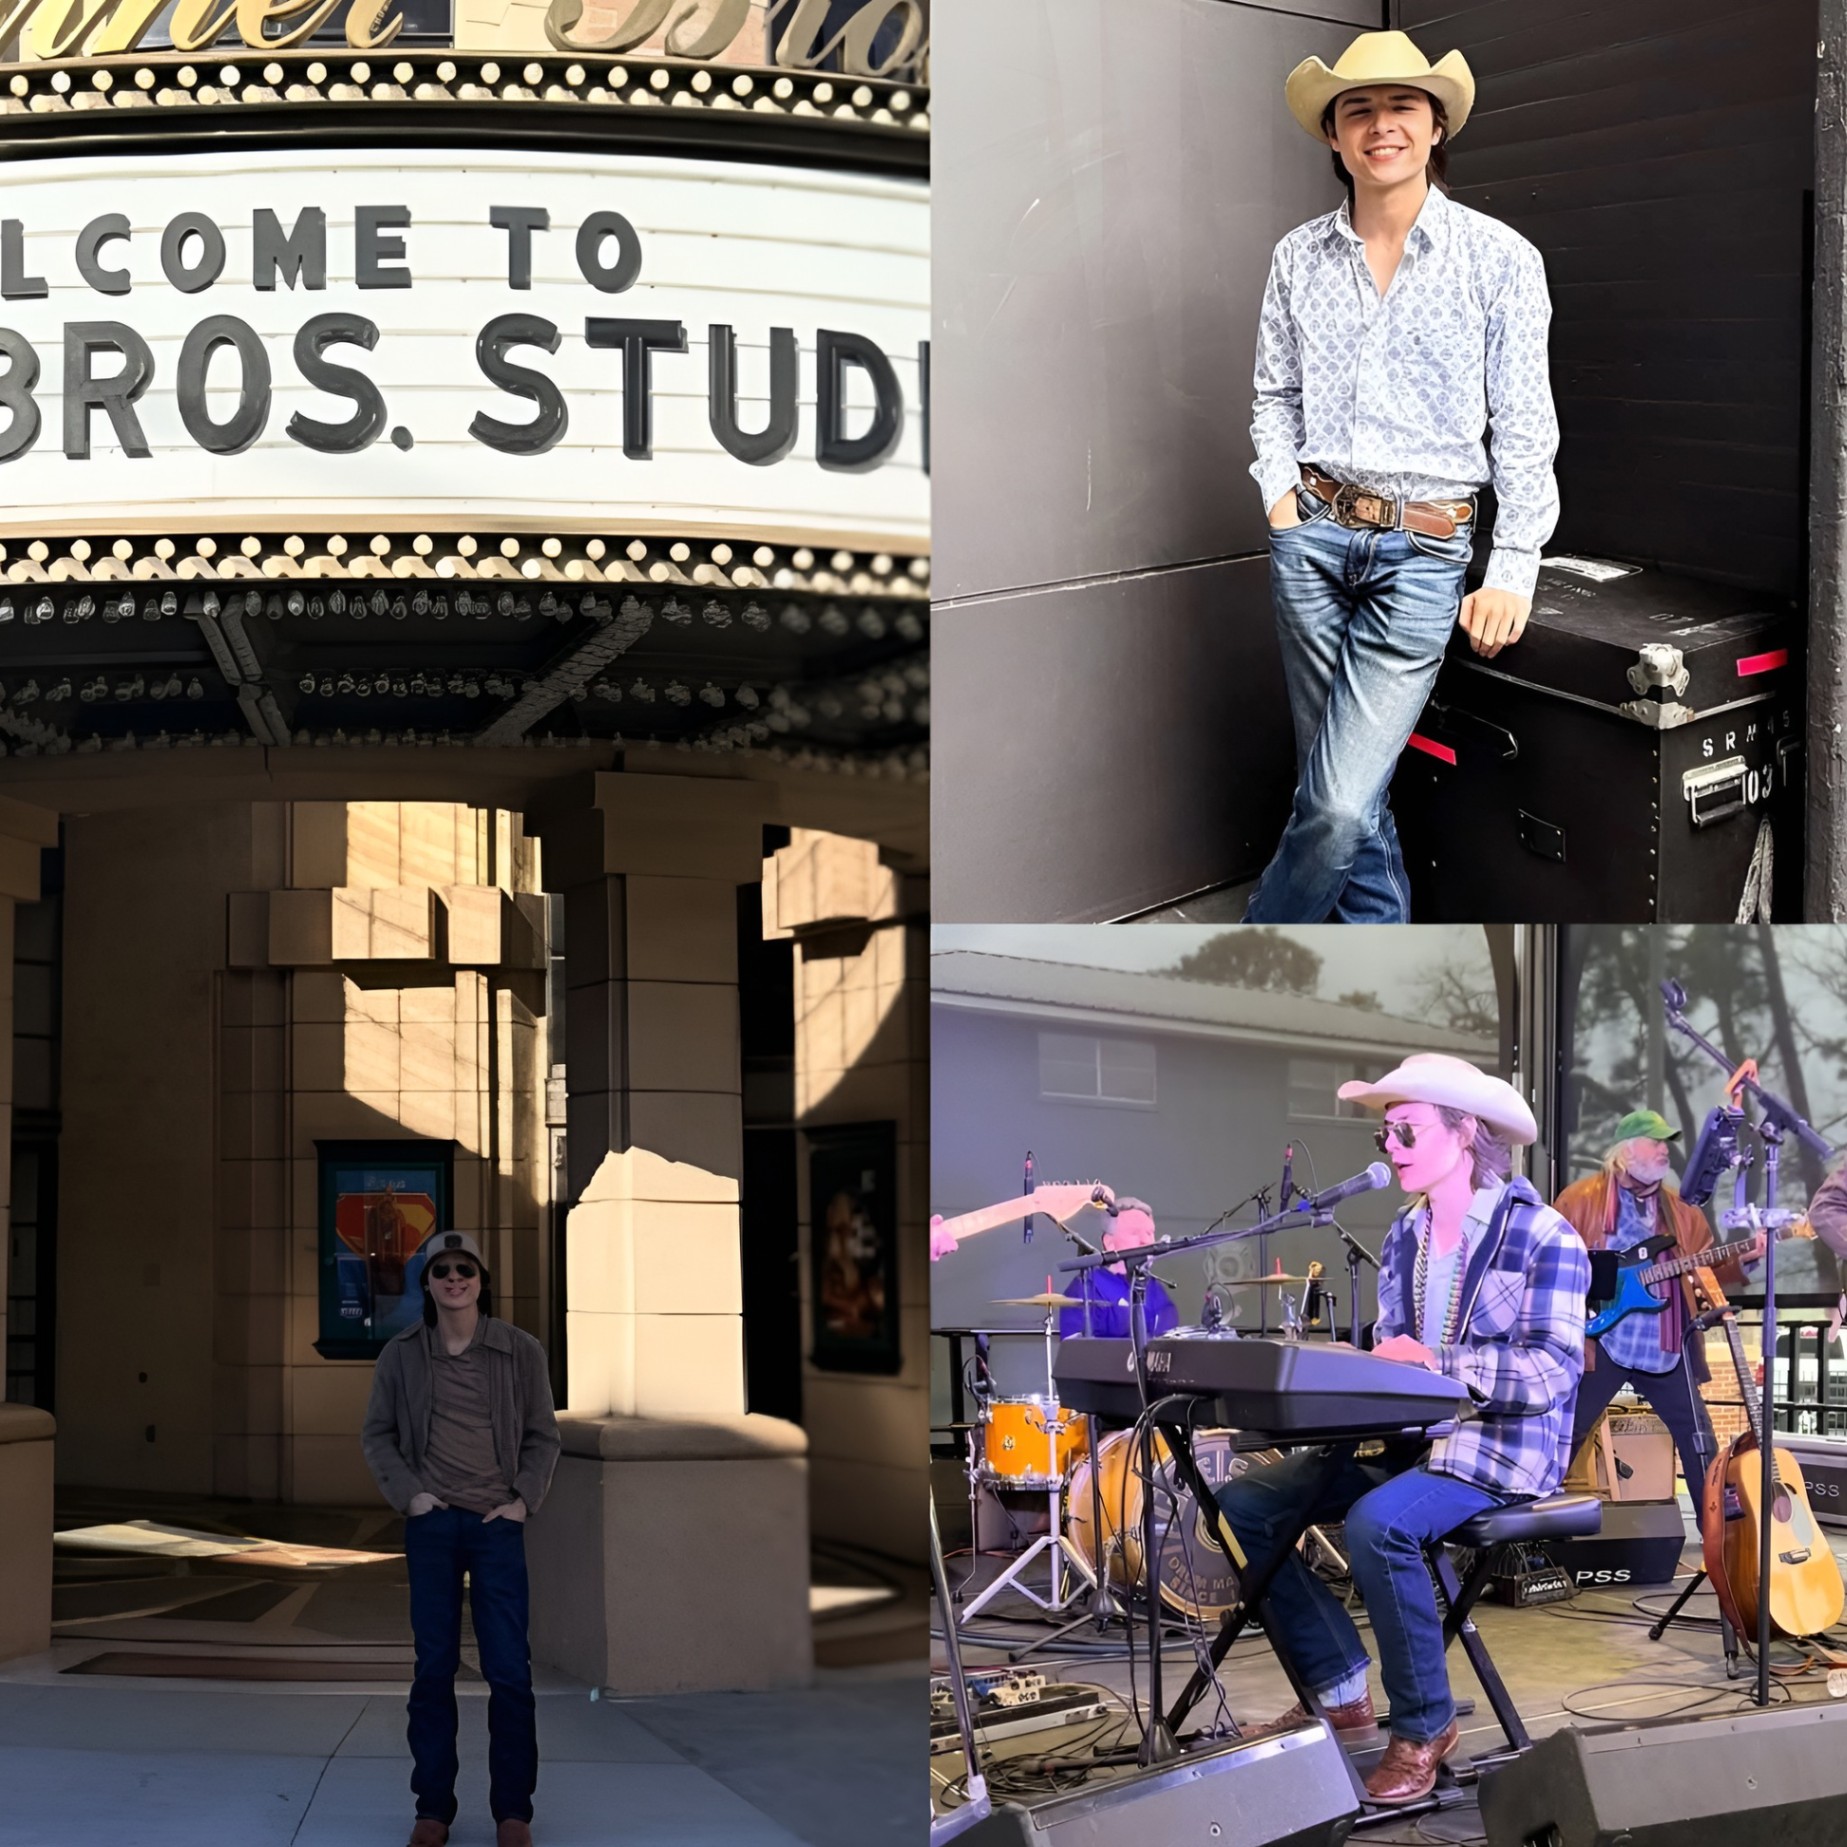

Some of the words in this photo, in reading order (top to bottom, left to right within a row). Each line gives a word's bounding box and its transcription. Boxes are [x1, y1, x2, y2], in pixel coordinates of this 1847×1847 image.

[490, 205, 642, 294] TO
[468, 313, 930, 478] STUD
[1804, 1481, 1840, 1497] PSS
[1576, 1569, 1631, 1586] PSS
